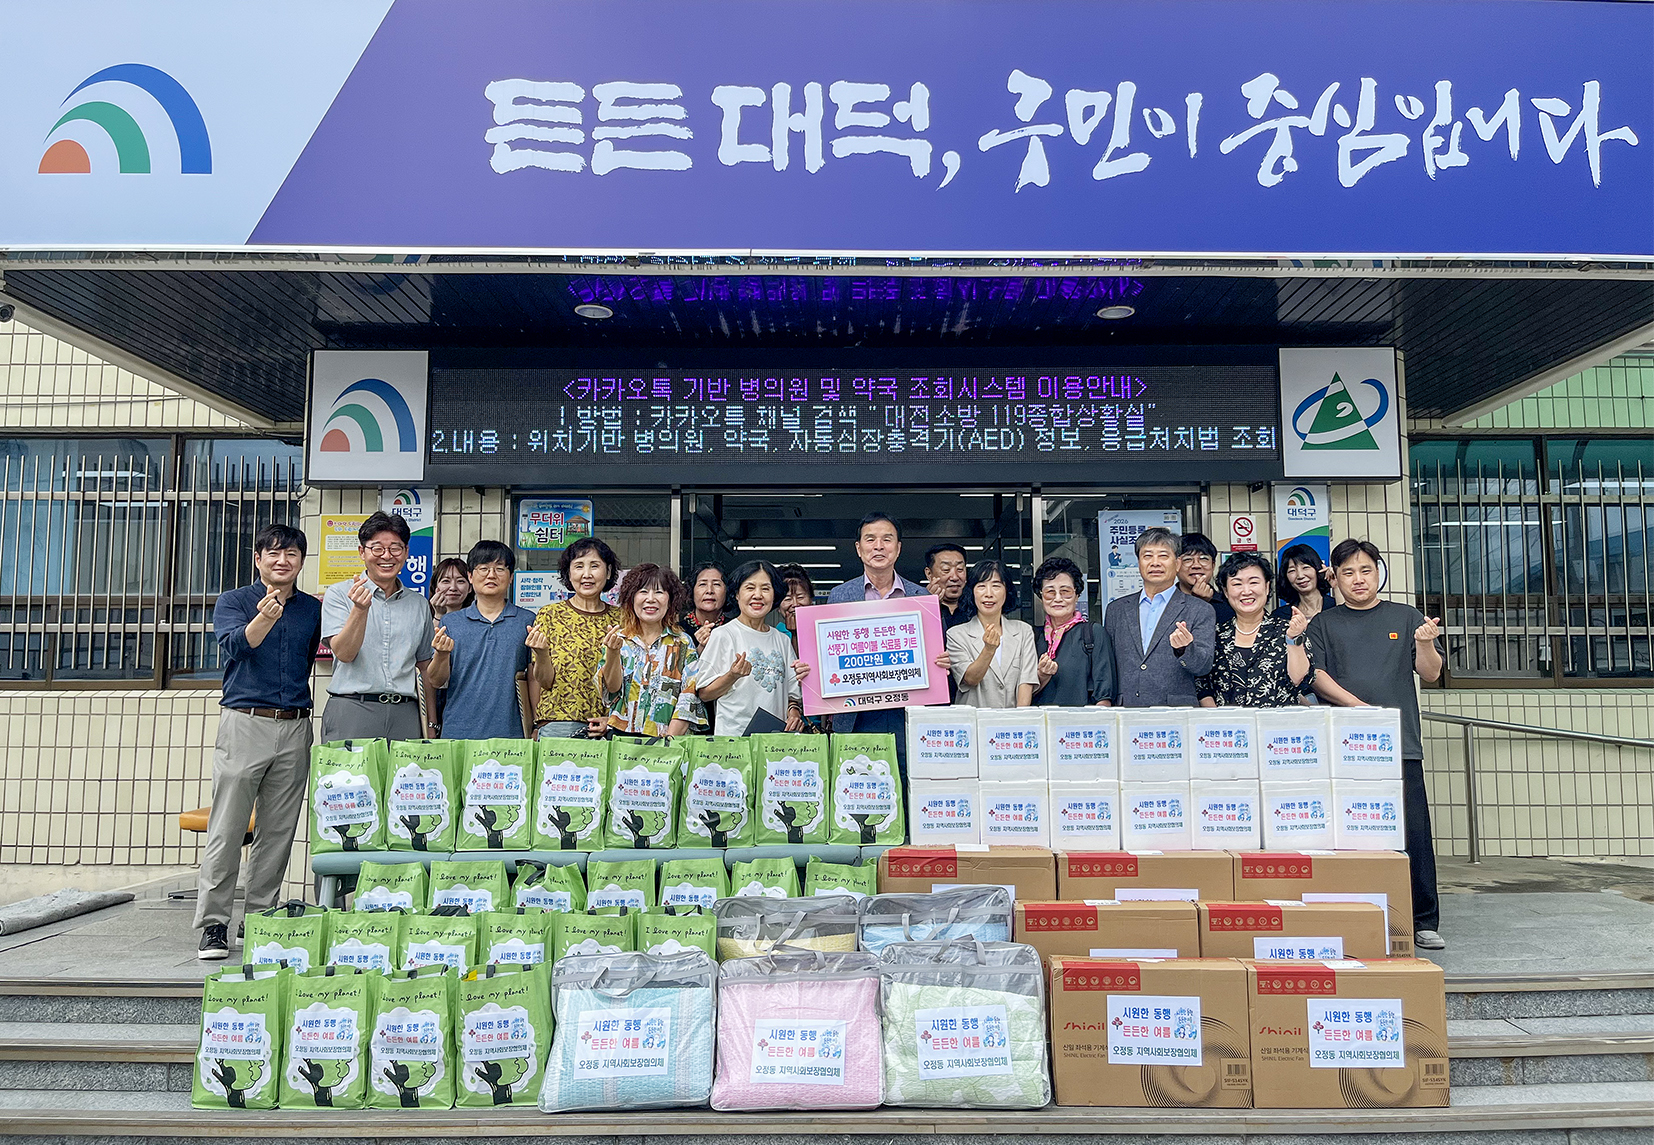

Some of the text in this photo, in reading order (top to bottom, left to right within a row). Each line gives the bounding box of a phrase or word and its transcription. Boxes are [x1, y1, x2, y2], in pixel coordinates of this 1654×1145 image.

[485, 69, 1639, 192] 든든 대덕, 주민이 중심입니다
[683, 378, 731, 401] 기반
[740, 378, 809, 401] 병의원
[821, 378, 841, 401] 및
[852, 377, 898, 401] 약국
[909, 376, 1026, 401] 조회시스템
[757, 405, 800, 429] 채널
[813, 405, 857, 429] 검색
[431, 430, 499, 454] 2.내용
[527, 429, 625, 454] 위치기반
[1100, 427, 1220, 453] 응급처치법
[1231, 427, 1277, 453] 조회
[392, 508, 422, 517] 대덕구
[1287, 507, 1317, 517] 대덕구
[530, 512, 564, 526] 무더위
[535, 527, 563, 544] 쉼터
[827, 623, 916, 641] 시원한 동행 든든한 여름
[827, 642, 848, 656] 선풍기
[880, 638, 902, 651] 식료품
[904, 637, 918, 650] 키트
[844, 652, 909, 668] 200만원 상당
[842, 668, 922, 685] 오정동지역사회보장협의체
[858, 692, 909, 706] 대덕구 오정동
[1269, 948, 1316, 959] 시원한 동행
[1122, 1007, 1149, 1020] 시원한
[1153, 1008, 1172, 1020] 동행
[1323, 1010, 1351, 1024] 시원한
[1355, 1011, 1373, 1024] 동행
[593, 1020, 620, 1032] 시원한
[624, 1019, 642, 1031] 동행
[931, 1018, 957, 1031] 시원한
[961, 1018, 979, 1030] 동행
[769, 1029, 796, 1041] 시원한
[799, 1030, 817, 1041] 동행
[1122, 1026, 1171, 1039] 든든한 여름
[1324, 1029, 1373, 1042] 든든한 여름
[591, 1037, 640, 1050] 든든한 여름
[932, 1036, 980, 1050] 든든한 여름
[768, 1046, 815, 1058] 든든한 여름
[1112, 1046, 1197, 1058] 오정동 지역사회보장협의체
[1314, 1050, 1400, 1061] 오정동 지역사회보장협의체
[755, 1065, 776, 1075] 오정동
[923, 1060, 944, 1070] 오정동
